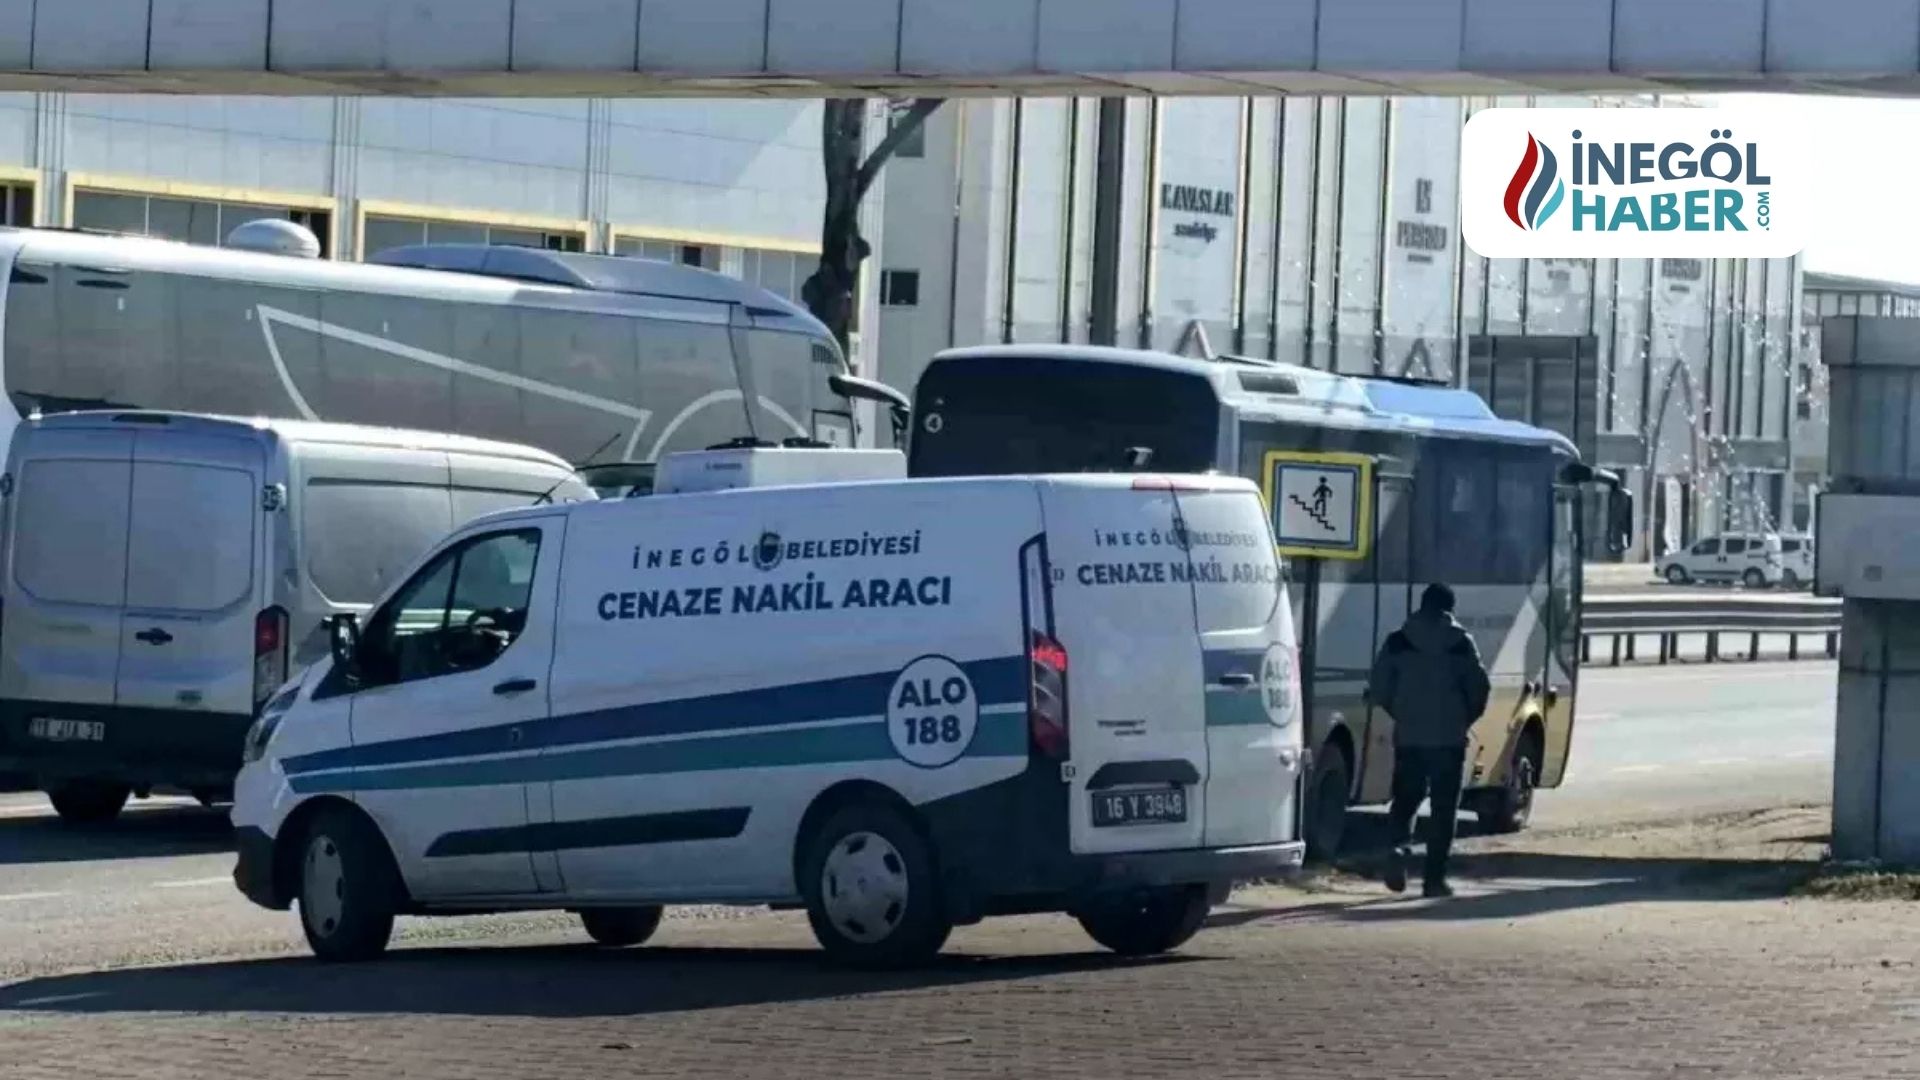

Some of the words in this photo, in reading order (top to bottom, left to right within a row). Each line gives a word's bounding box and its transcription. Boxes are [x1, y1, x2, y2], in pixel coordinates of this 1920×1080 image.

[633, 540, 749, 569] İNEGÖL
[786, 529, 922, 560] BELEDİYESİ
[1078, 561, 1165, 585] CENAZE
[1170, 554, 1228, 583] NAKİL
[597, 586, 723, 621] CENAZE
[731, 571, 835, 614] NAKİL
[842, 575, 952, 609] ARACI
[897, 677, 967, 708] ALO
[904, 716, 961, 746] 188
[1106, 797, 1125, 819] 16
[1128, 796, 1139, 818] Y
